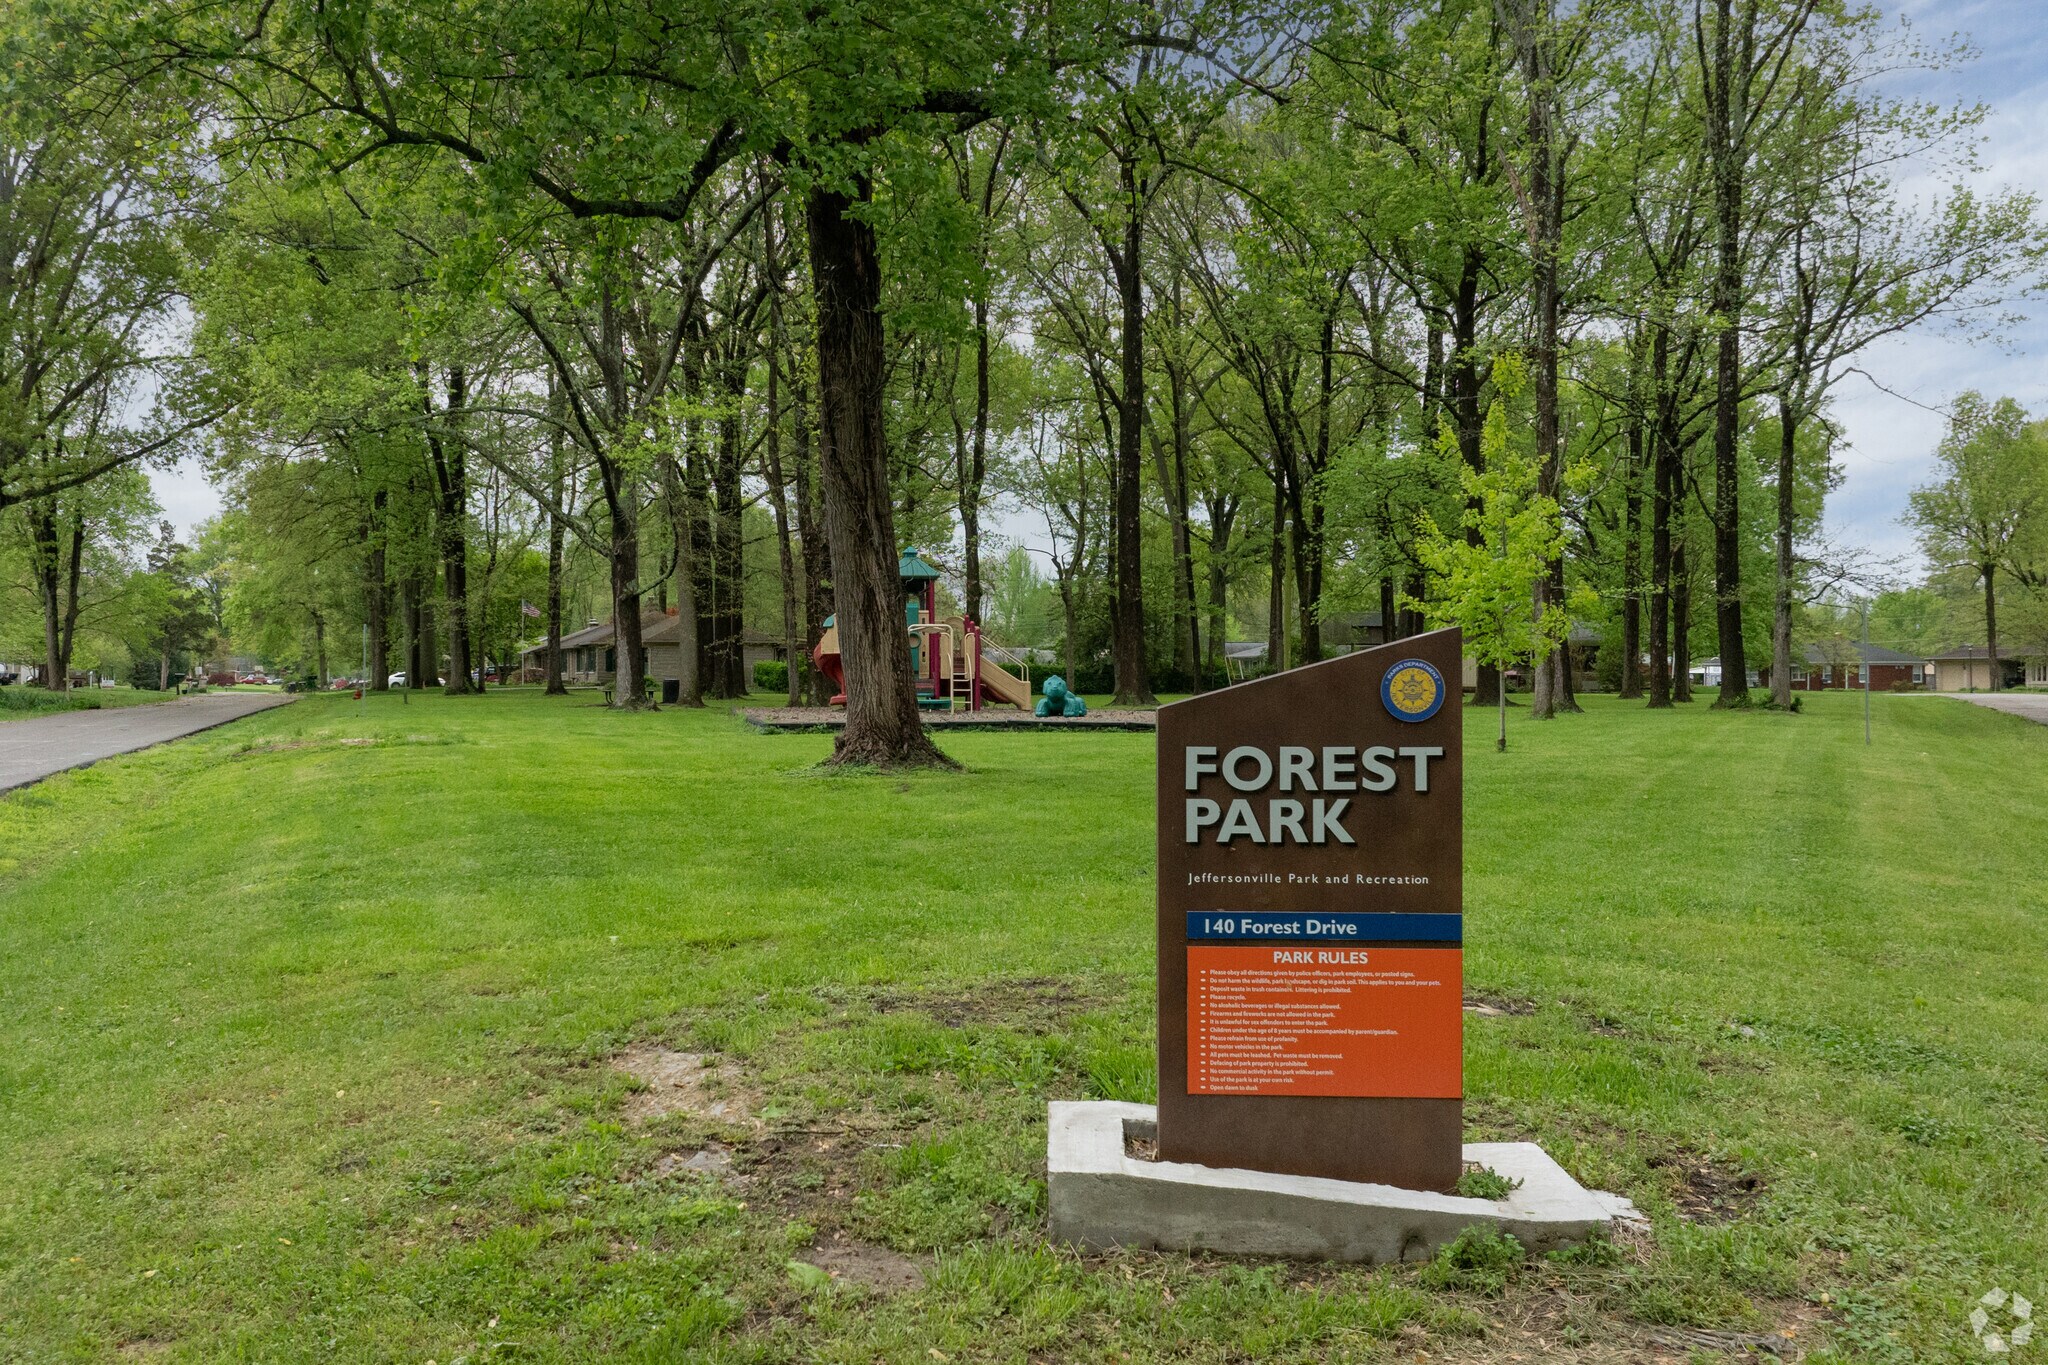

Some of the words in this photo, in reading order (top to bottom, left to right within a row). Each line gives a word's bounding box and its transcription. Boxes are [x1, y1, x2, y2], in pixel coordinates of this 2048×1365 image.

[1387, 664, 1404, 680] PARKS
[1404, 661, 1440, 680] DEPARTMENT
[1185, 746, 1443, 792] FOREST
[1186, 799, 1355, 843] PARK
[1188, 873, 1281, 885] Jeffersonville
[1289, 873, 1319, 884] Park
[1325, 874, 1349, 884] and
[1356, 874, 1429, 884] Recreation
[1203, 919, 1235, 934] 140
[1241, 920, 1300, 934] Forest
[1306, 920, 1357, 935] Drive
[1273, 951, 1313, 964] PARK
[1318, 952, 1369, 964] RULES
